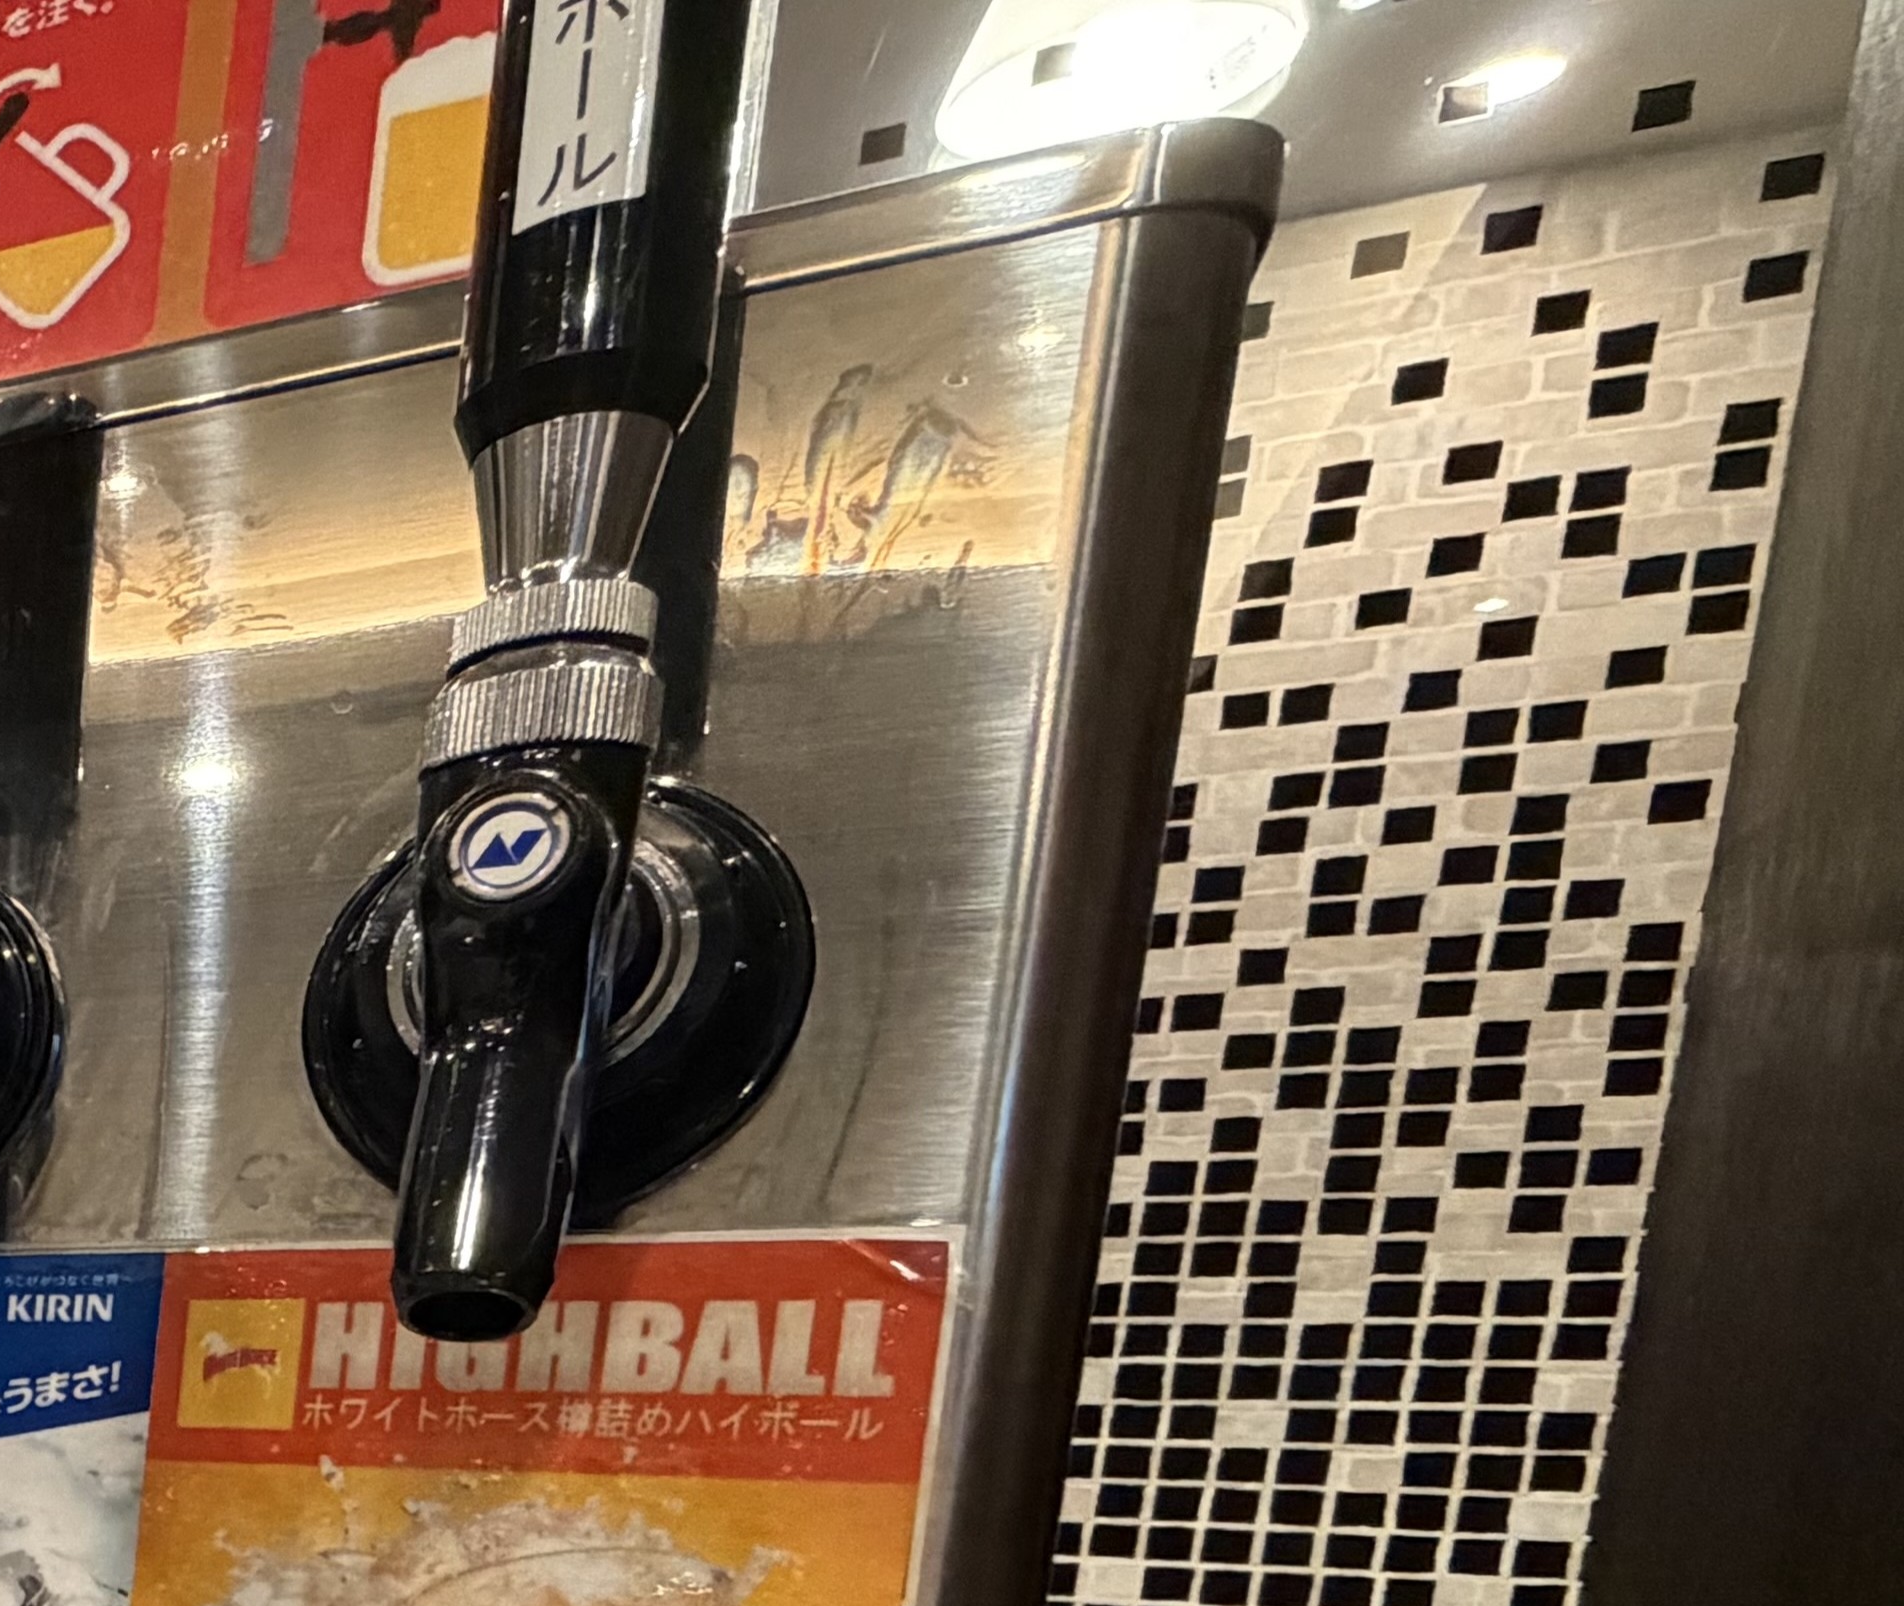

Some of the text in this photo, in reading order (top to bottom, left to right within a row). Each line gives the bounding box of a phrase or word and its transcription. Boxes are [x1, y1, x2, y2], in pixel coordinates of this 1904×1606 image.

[7, 1293, 115, 1323] KIRIN
[308, 1299, 896, 1399] HIGHBALL
[301, 1395, 886, 1442] ホワイトホース樽詰めハイボール
